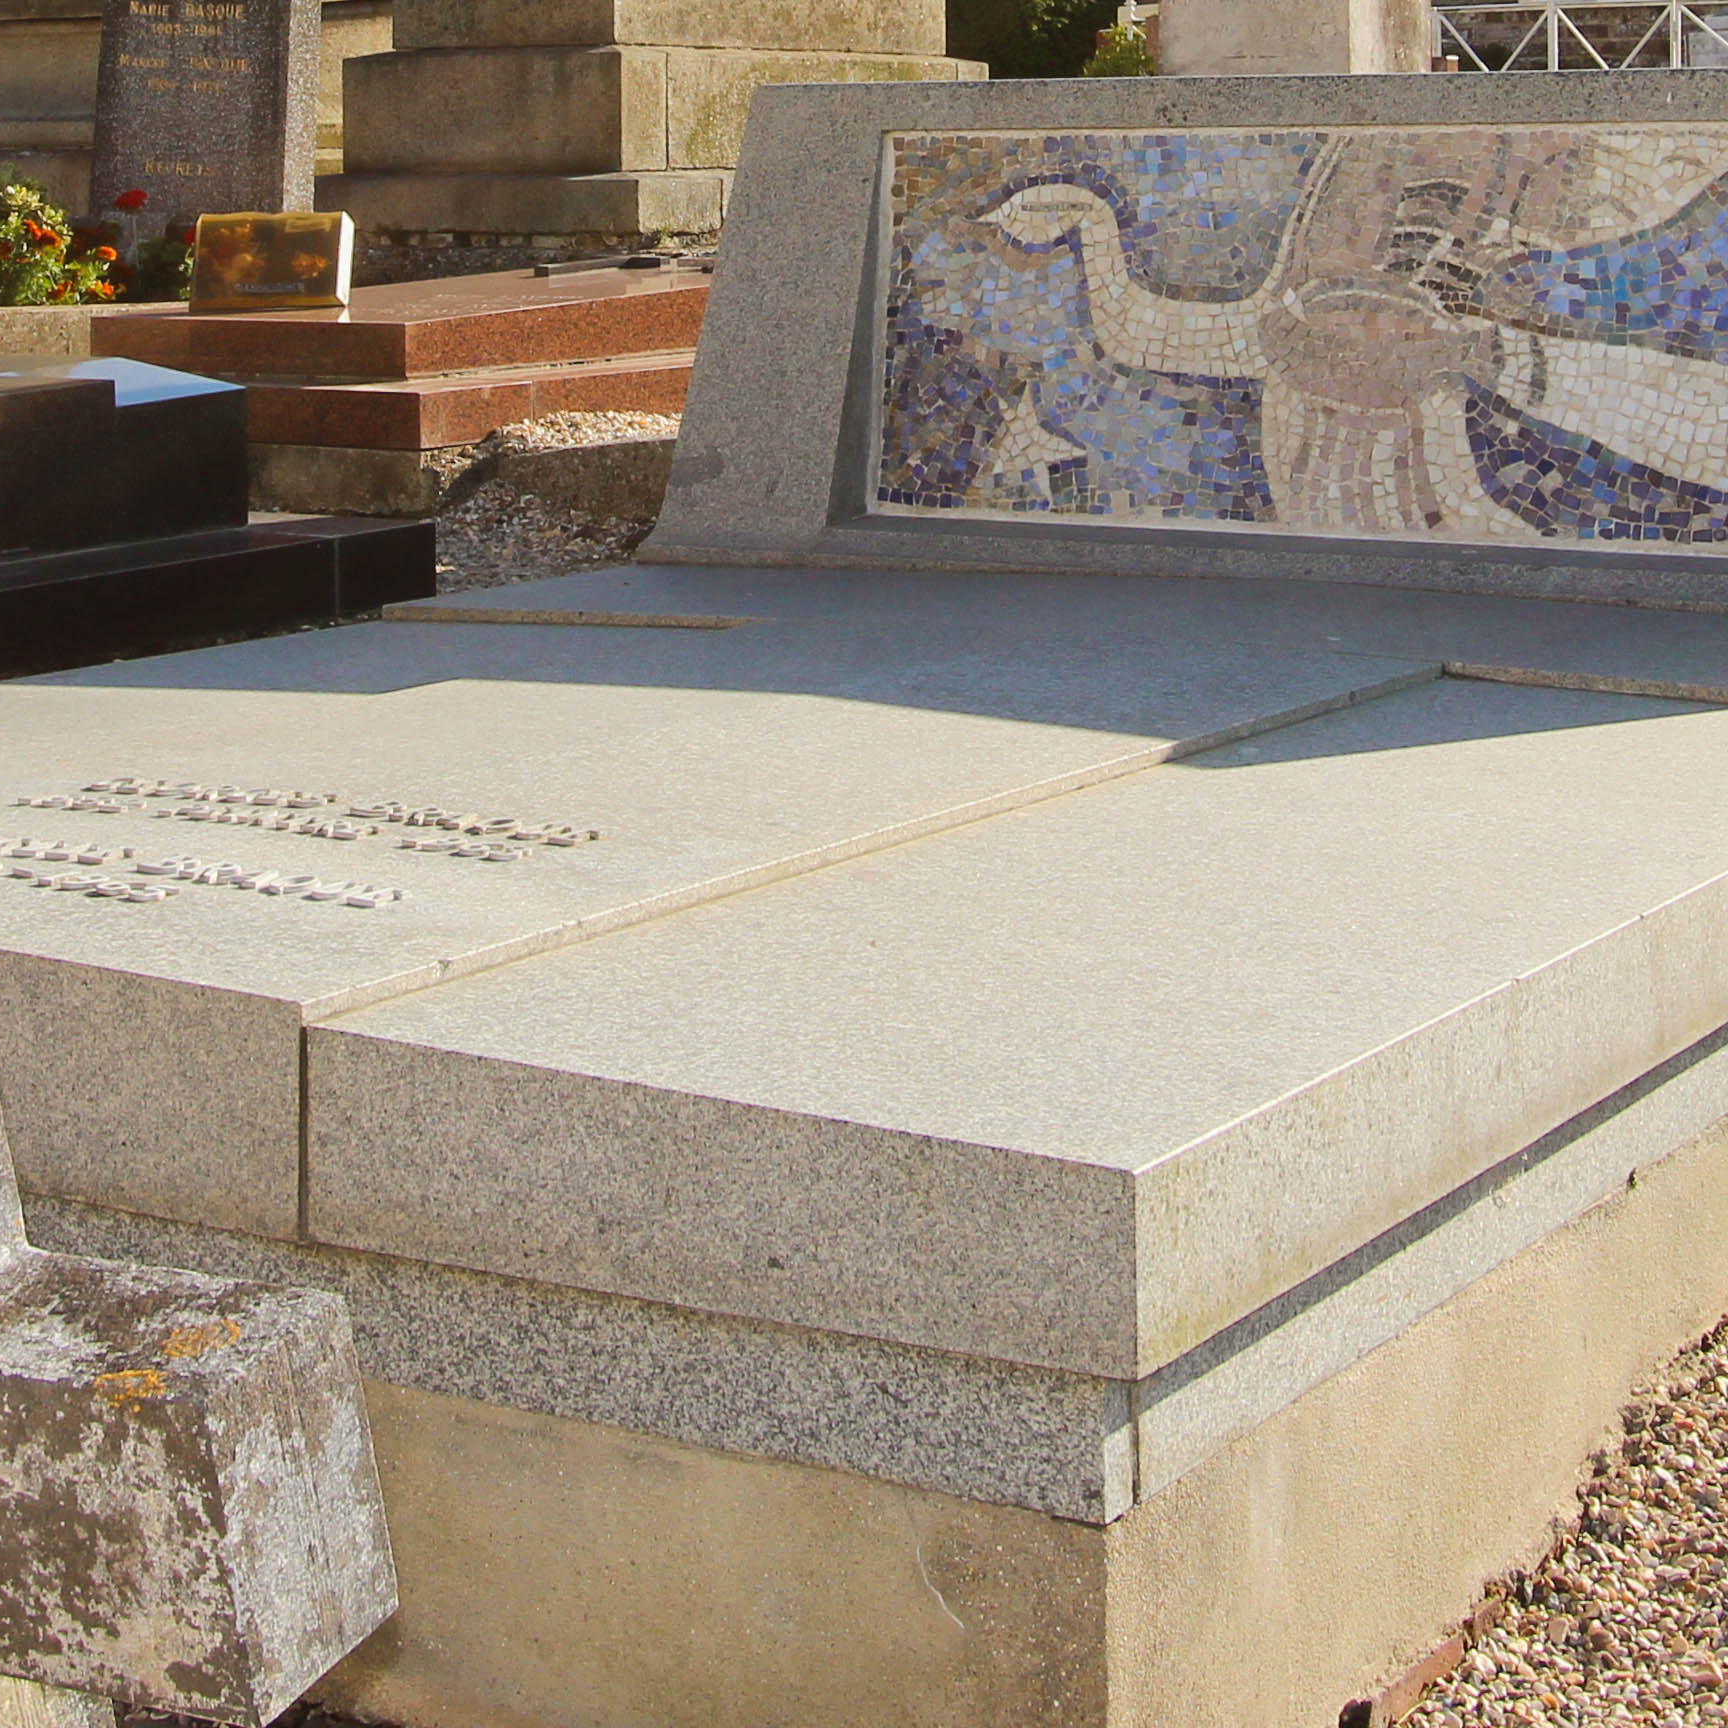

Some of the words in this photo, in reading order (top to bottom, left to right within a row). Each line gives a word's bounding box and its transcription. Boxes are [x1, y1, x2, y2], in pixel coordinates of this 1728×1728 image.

[129, 0, 171, 17] MARIE
[185, 2, 244, 20] BASQUE
[88, 777, 338, 808] GEORGES
[349, 801, 603, 847] BRAQUE
[37, 871, 181, 903] 1965
[136, 855, 411, 908] BRAQUE
